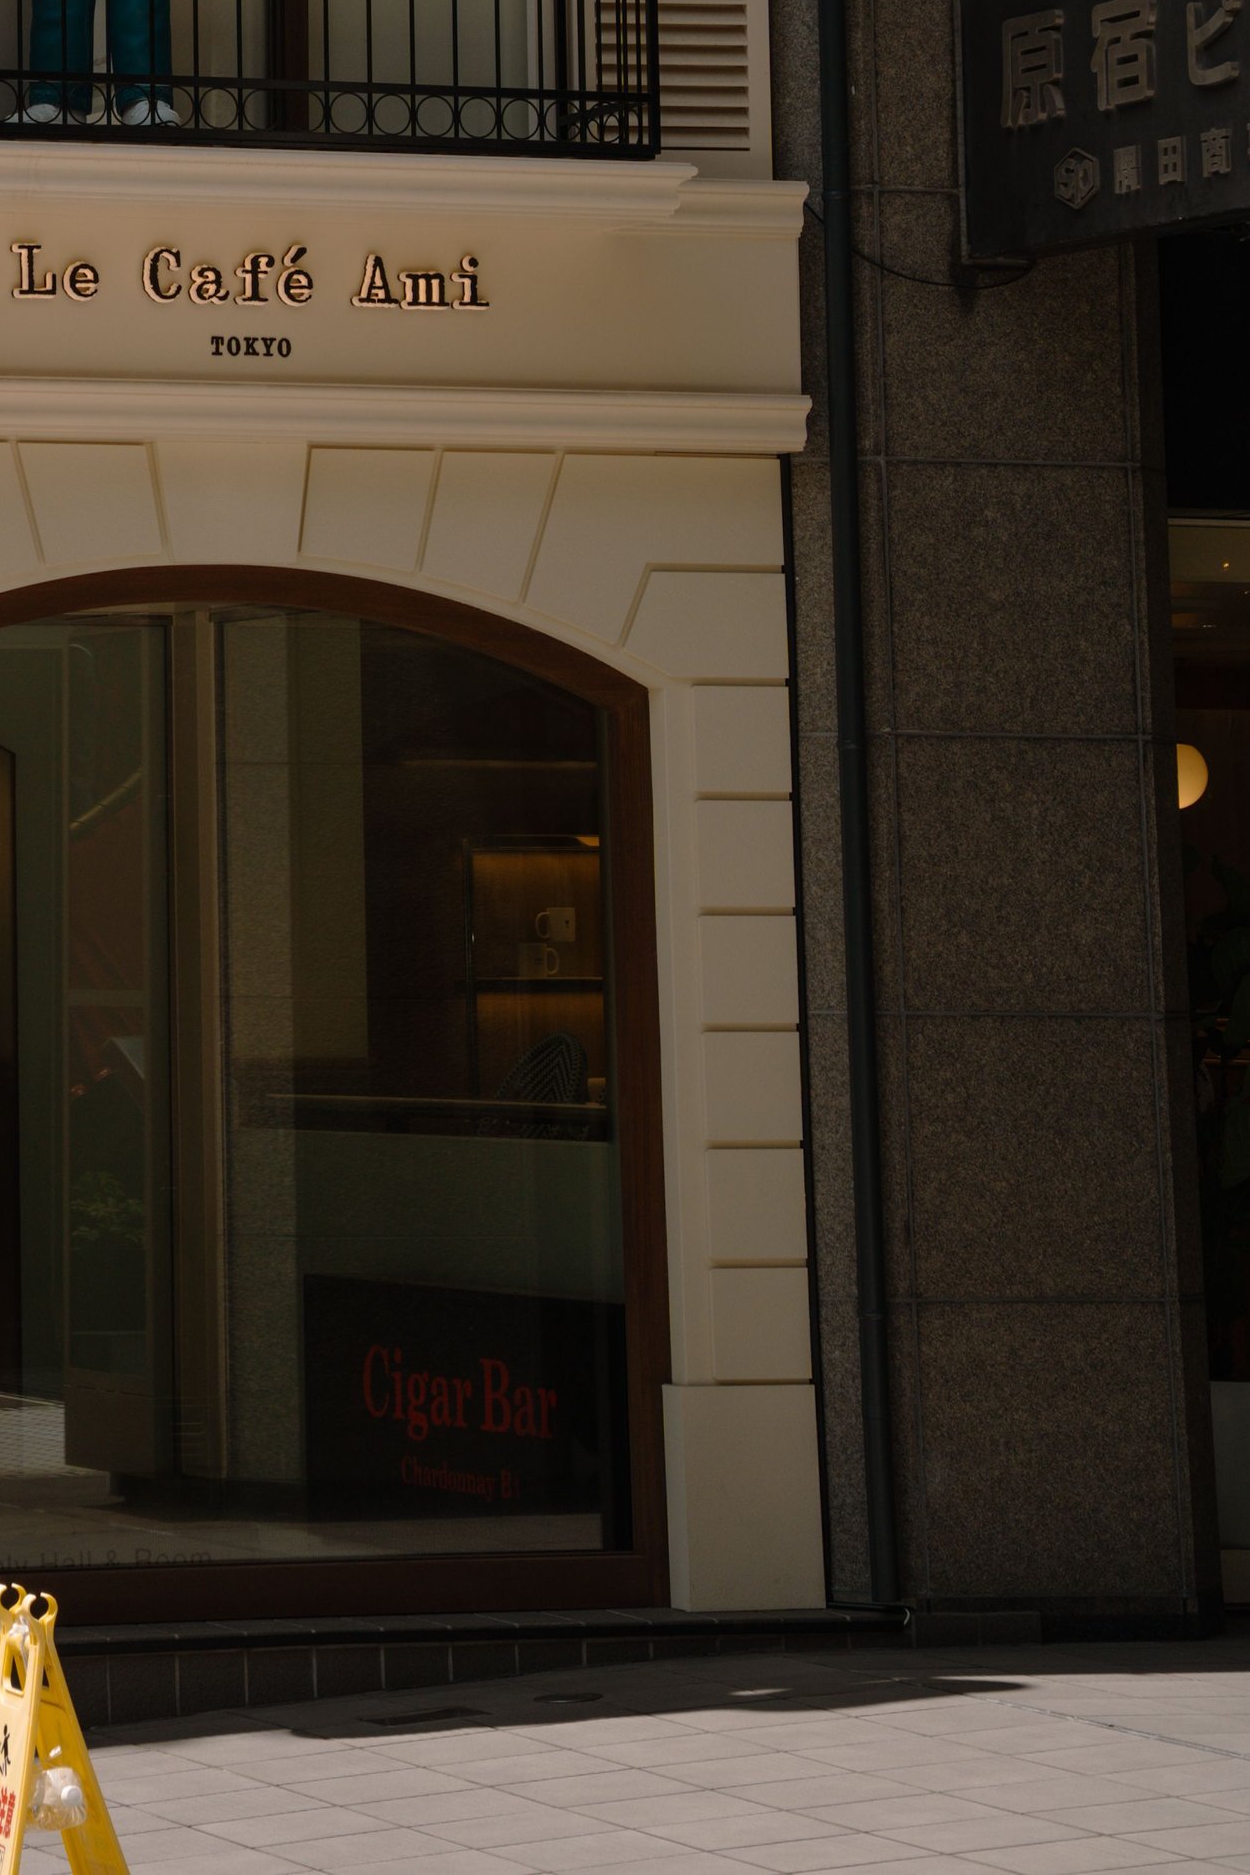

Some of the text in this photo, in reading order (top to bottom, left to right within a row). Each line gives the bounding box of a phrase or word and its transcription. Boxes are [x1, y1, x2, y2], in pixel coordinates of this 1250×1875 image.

[11, 243, 490, 310] Le Café Ami
[210, 335, 292, 358] TOKYO
[362, 1343, 558, 1441] Cigar Bar
[400, 1454, 497, 1503] Chardonnay
